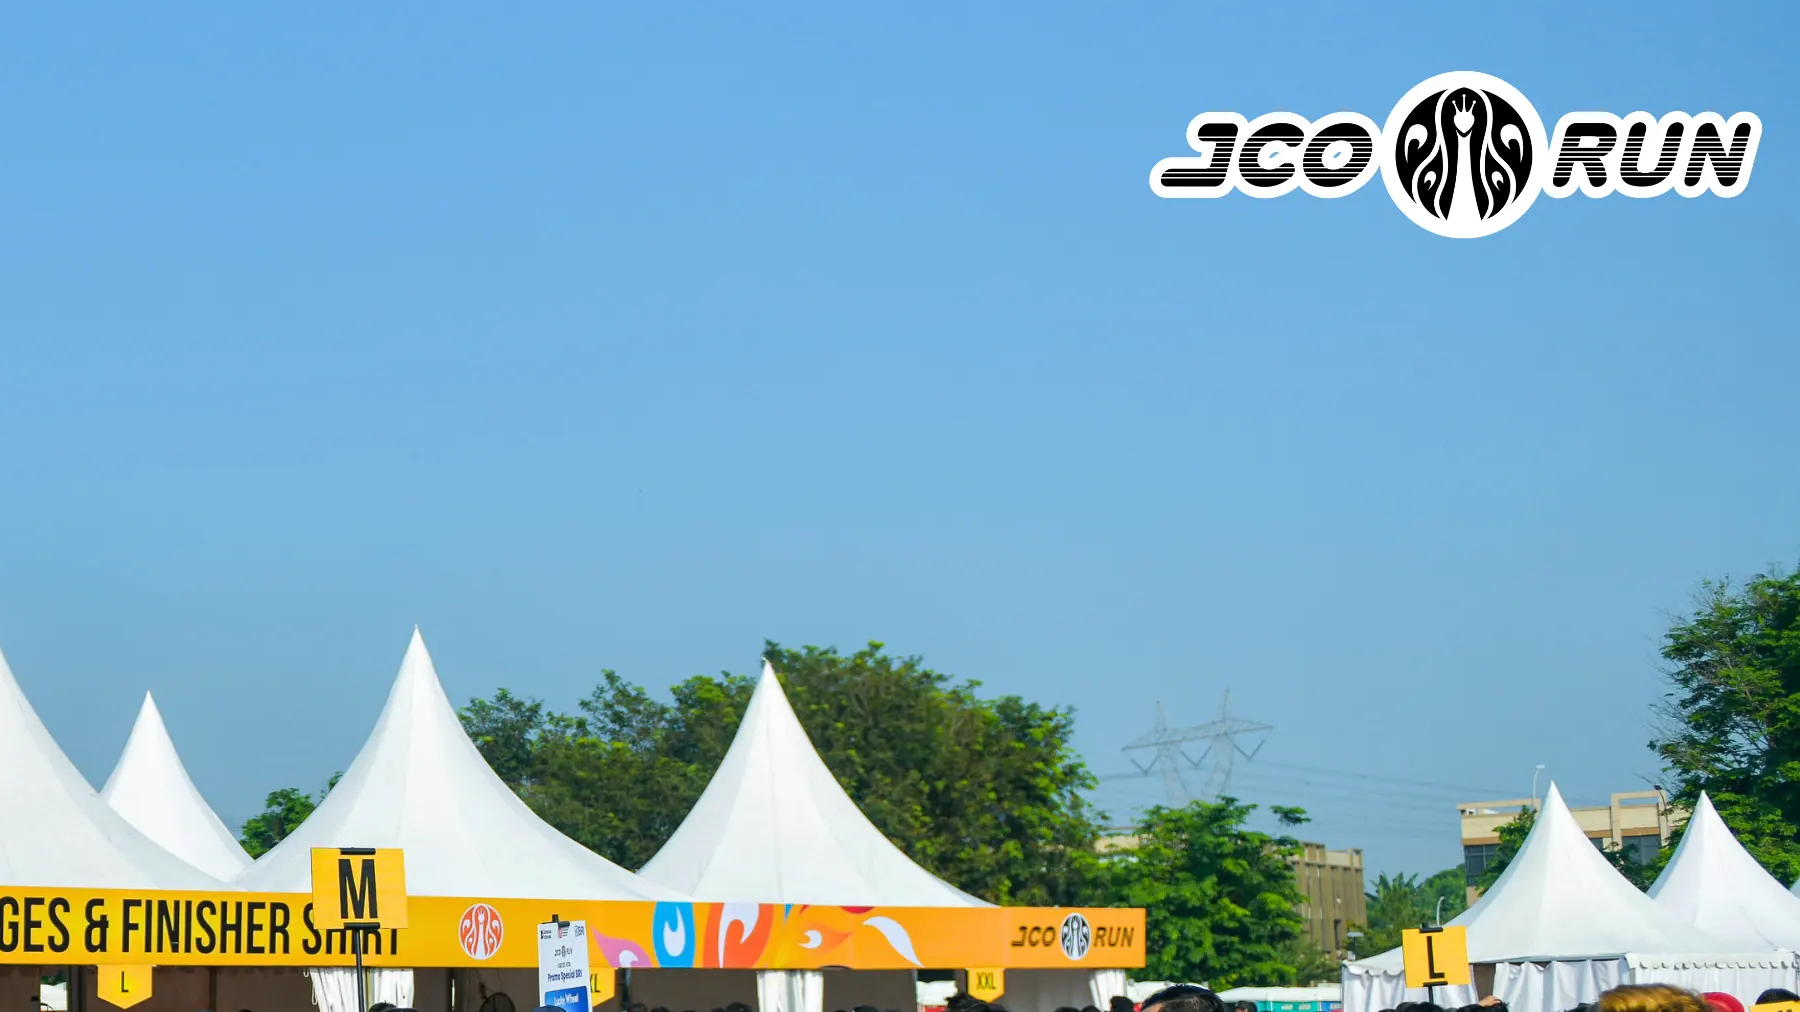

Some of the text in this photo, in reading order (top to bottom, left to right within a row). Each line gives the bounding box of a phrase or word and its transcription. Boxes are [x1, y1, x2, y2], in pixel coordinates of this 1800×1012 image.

[338, 859, 378, 919] M
[84, 898, 109, 954] &
[122, 899, 291, 955] FINISHER
[1010, 926, 1135, 947] JCO RUN
[1426, 935, 1446, 979] L
[121, 971, 130, 994] L
[975, 972, 997, 990] XXL
